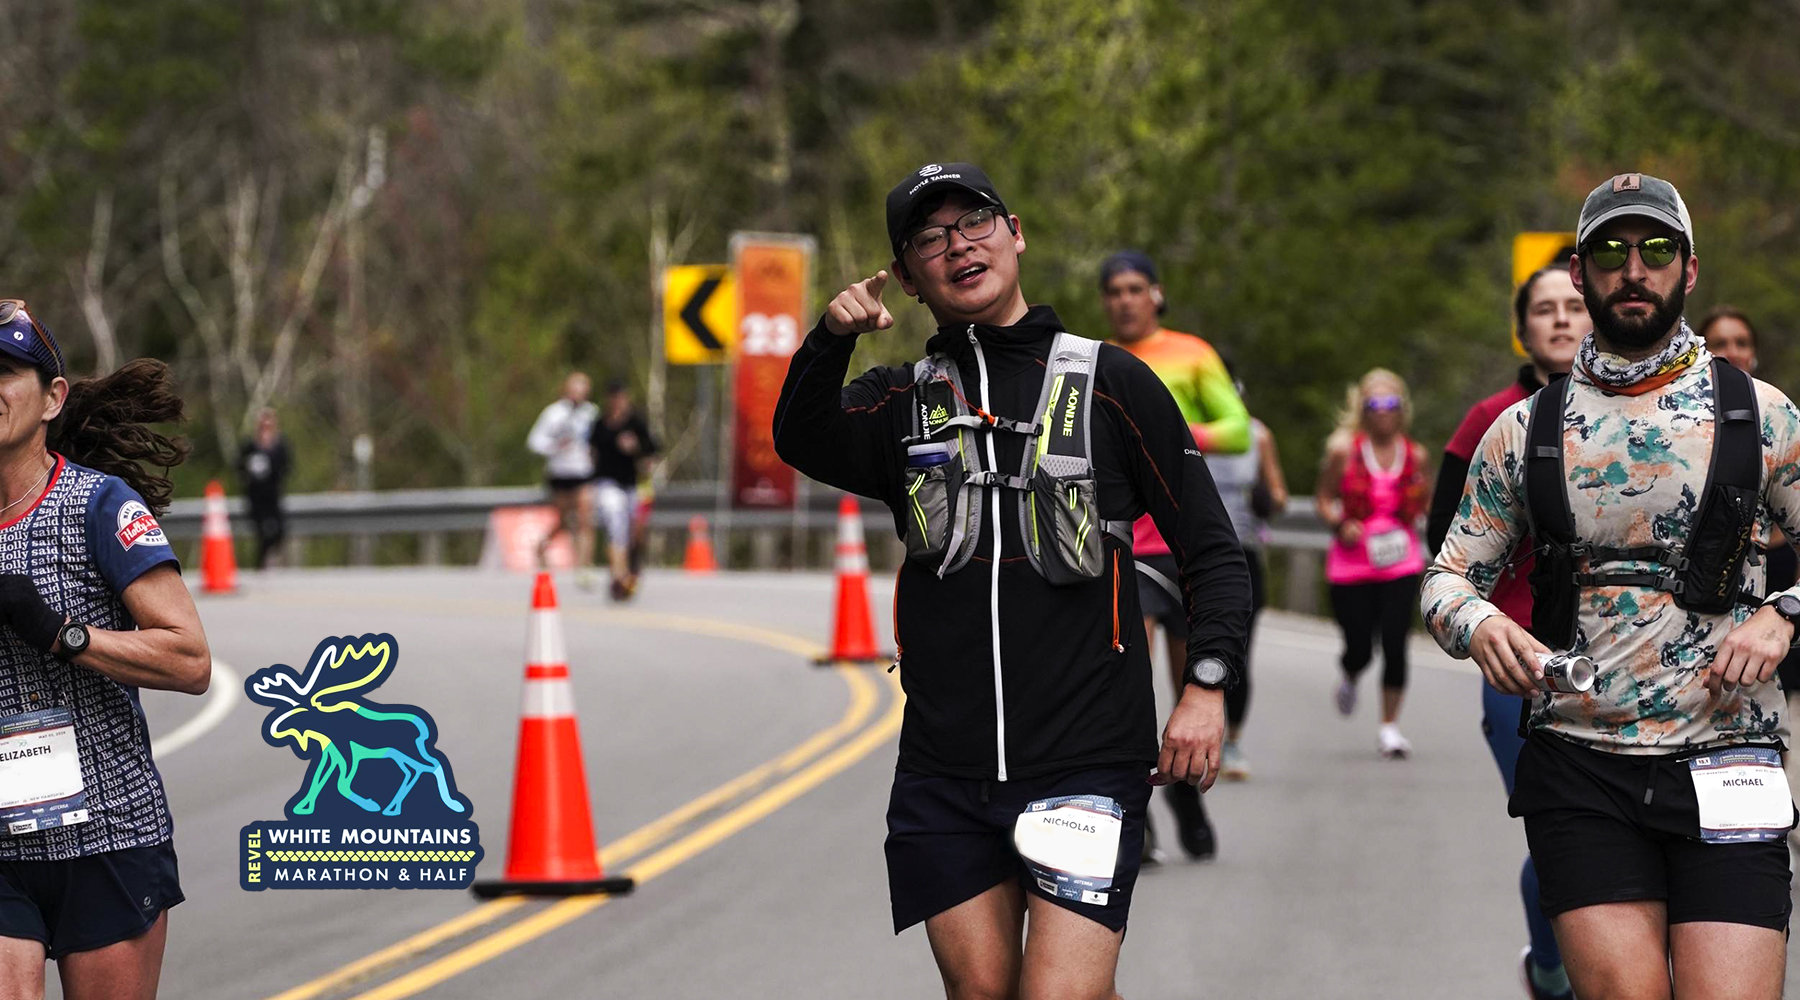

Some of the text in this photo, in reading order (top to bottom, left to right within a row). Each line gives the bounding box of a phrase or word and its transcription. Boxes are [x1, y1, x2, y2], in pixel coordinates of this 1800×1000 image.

[909, 173, 961, 195] HOYLE TANNER
[743, 313, 797, 356] 23
[1063, 386, 1080, 437] AONIJIE
[63, 507, 86, 516] this
[63, 516, 85, 525] this
[32, 527, 59, 538] said
[62, 526, 85, 536] this
[32, 537, 59, 547] said
[61, 536, 86, 545] this
[31, 546, 59, 557] said
[61, 545, 86, 555] this
[31, 556, 59, 566] said
[61, 555, 87, 564] this
[31, 565, 58, 576] said
[32, 573, 60, 586] said
[62, 580, 84, 590] this
[65, 596, 86, 609] this
[90, 604, 110, 619] was
[19, 679, 51, 694] Holly
[20, 690, 54, 702] Hlly
[22, 699, 56, 712] Holly
[0, 745, 52, 762] ELIZABETH
[98, 760, 119, 771] this
[100, 768, 122, 780] this
[121, 759, 138, 771] was
[102, 777, 123, 790] this
[125, 767, 142, 781] was
[1722, 778, 1764, 787] MICHAEL
[103, 786, 125, 800] this
[126, 777, 146, 790] was
[105, 795, 128, 809] this
[128, 785, 150, 800] was
[132, 794, 153, 808] was
[133, 805, 153, 818] was
[134, 814, 155, 827] was
[1043, 817, 1096, 834] NICHOLAS
[82, 829, 108, 841] said
[111, 832, 135, 841] this
[138, 825, 157, 836] was
[46, 839, 80, 853] Holly
[83, 837, 109, 852] said
[113, 838, 137, 851] this
[138, 833, 159, 844] was
